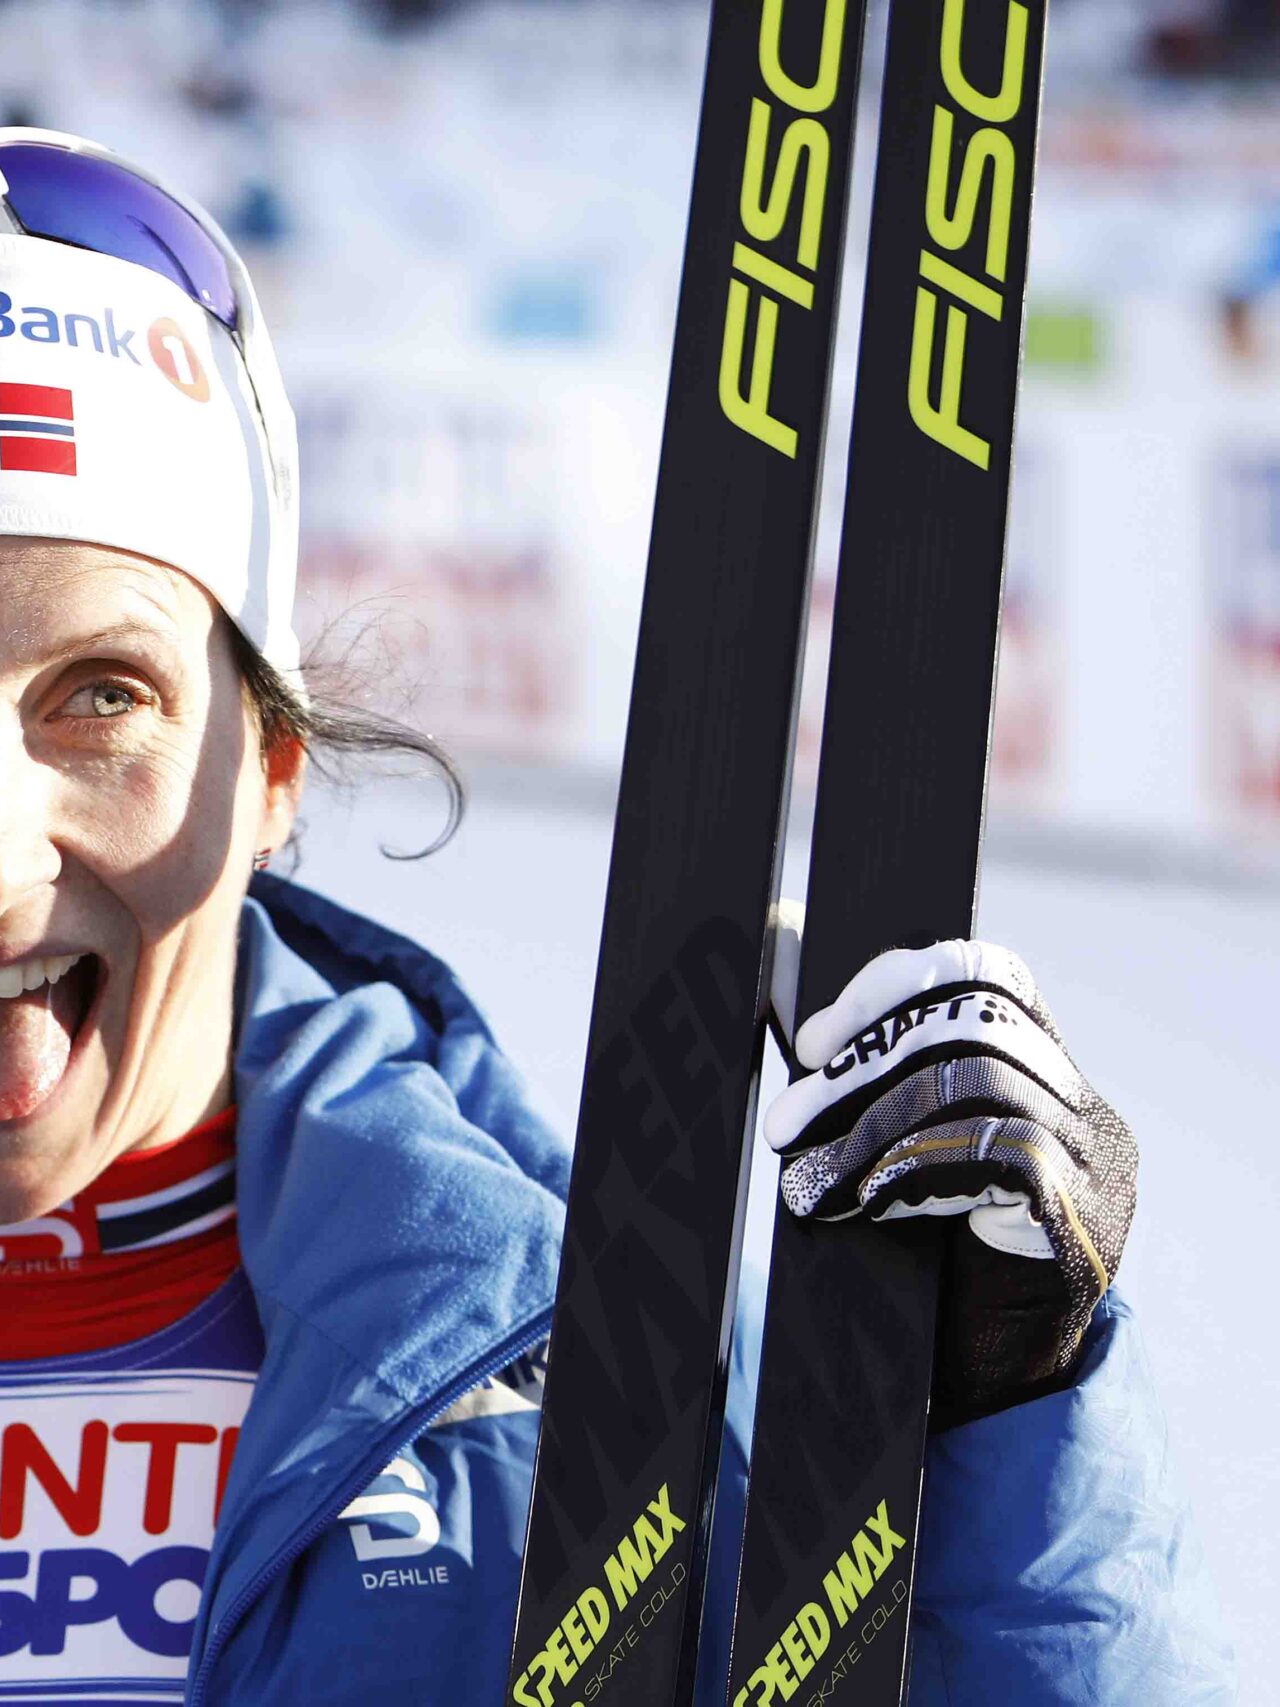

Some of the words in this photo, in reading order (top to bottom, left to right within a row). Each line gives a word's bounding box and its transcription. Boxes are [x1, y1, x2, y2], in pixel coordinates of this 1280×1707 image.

[823, 994, 977, 1080] CRAFT
[361, 1565, 450, 1590] DÆHLIE
[512, 1586, 611, 1707] SPEED
[603, 1482, 687, 1613] MAX
[822, 1498, 907, 1630] MAX
[861, 1579, 908, 1645] COLD
[584, 1624, 640, 1702] SKATE
[639, 1562, 687, 1628] COLD
